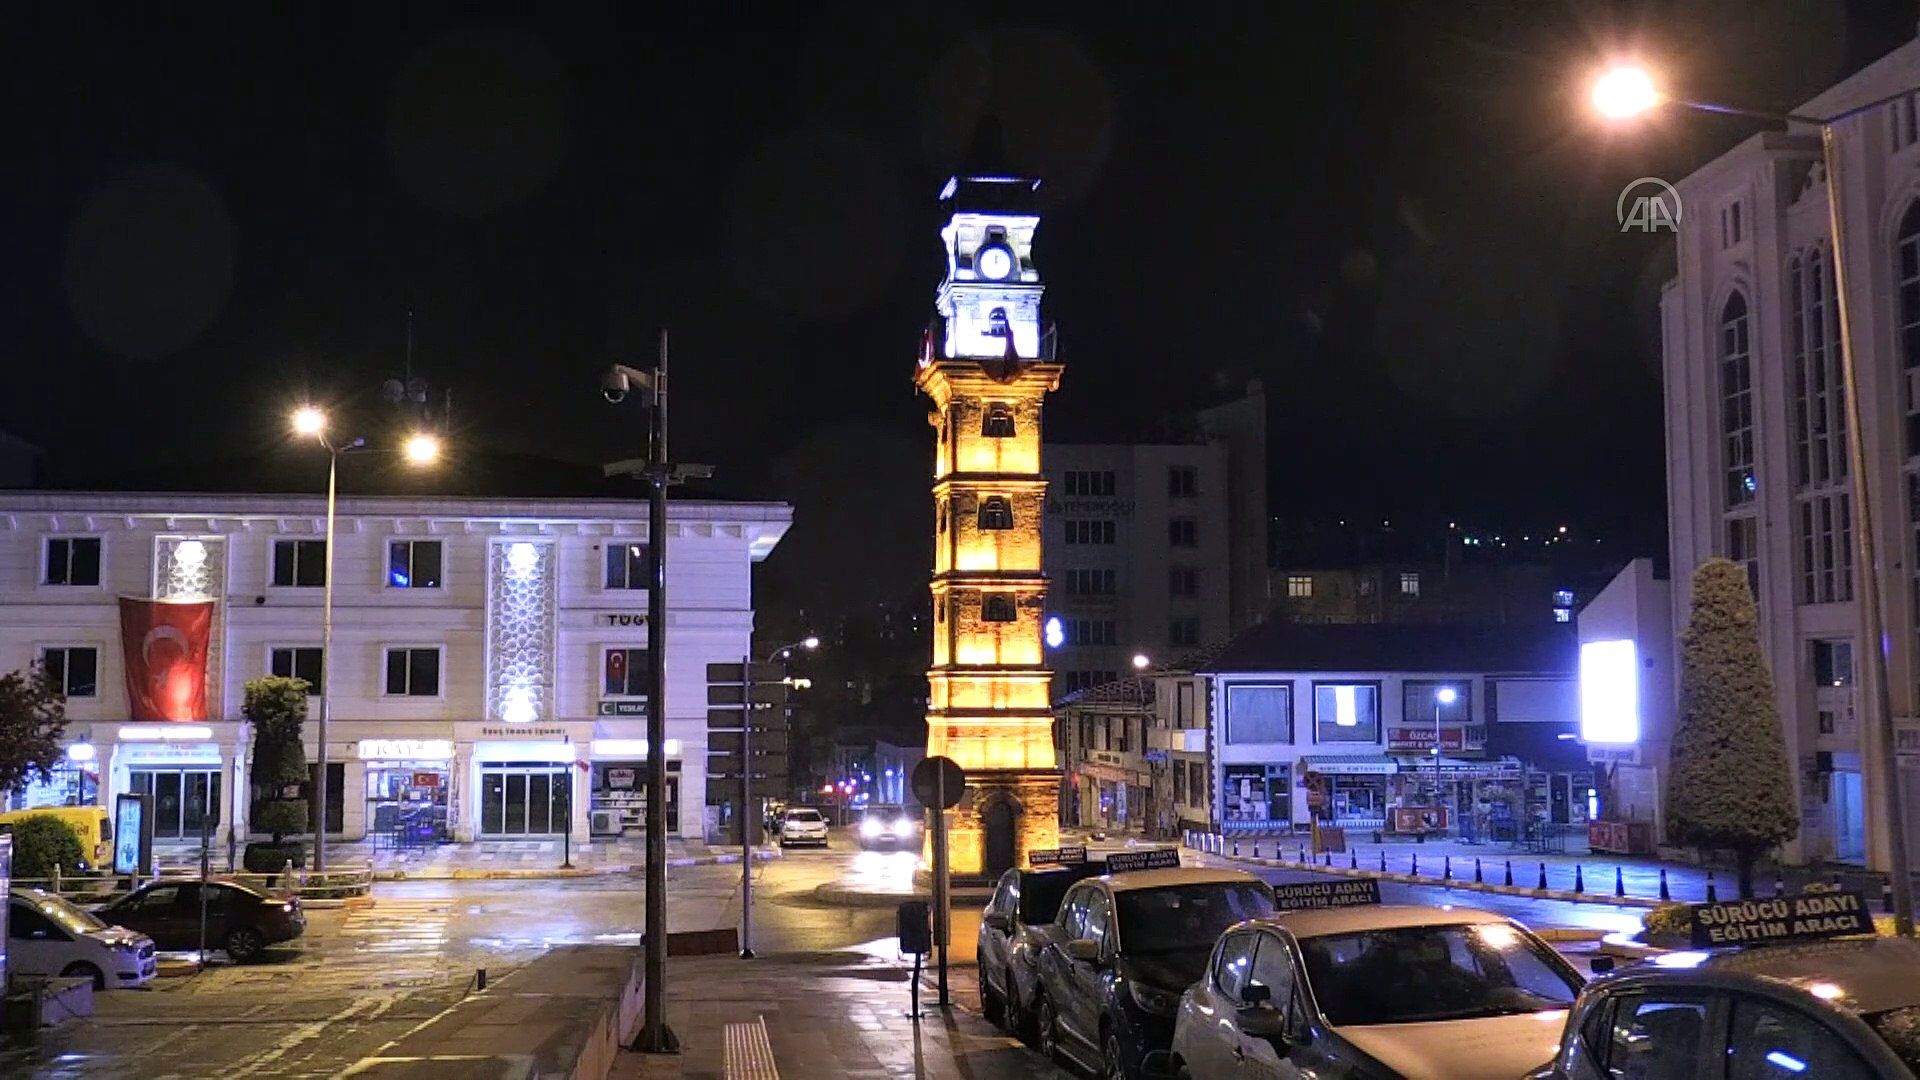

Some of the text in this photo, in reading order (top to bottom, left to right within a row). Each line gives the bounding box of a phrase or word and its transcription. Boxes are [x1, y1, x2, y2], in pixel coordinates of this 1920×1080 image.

[1335, 882, 1373, 894] ADAYI
[1281, 894, 1373, 908] EĞİTİM ARACI
[1698, 895, 1859, 925] SÜRÜCÜ ADAYI
[1709, 915, 1859, 942] EĞİTİM ARACI
